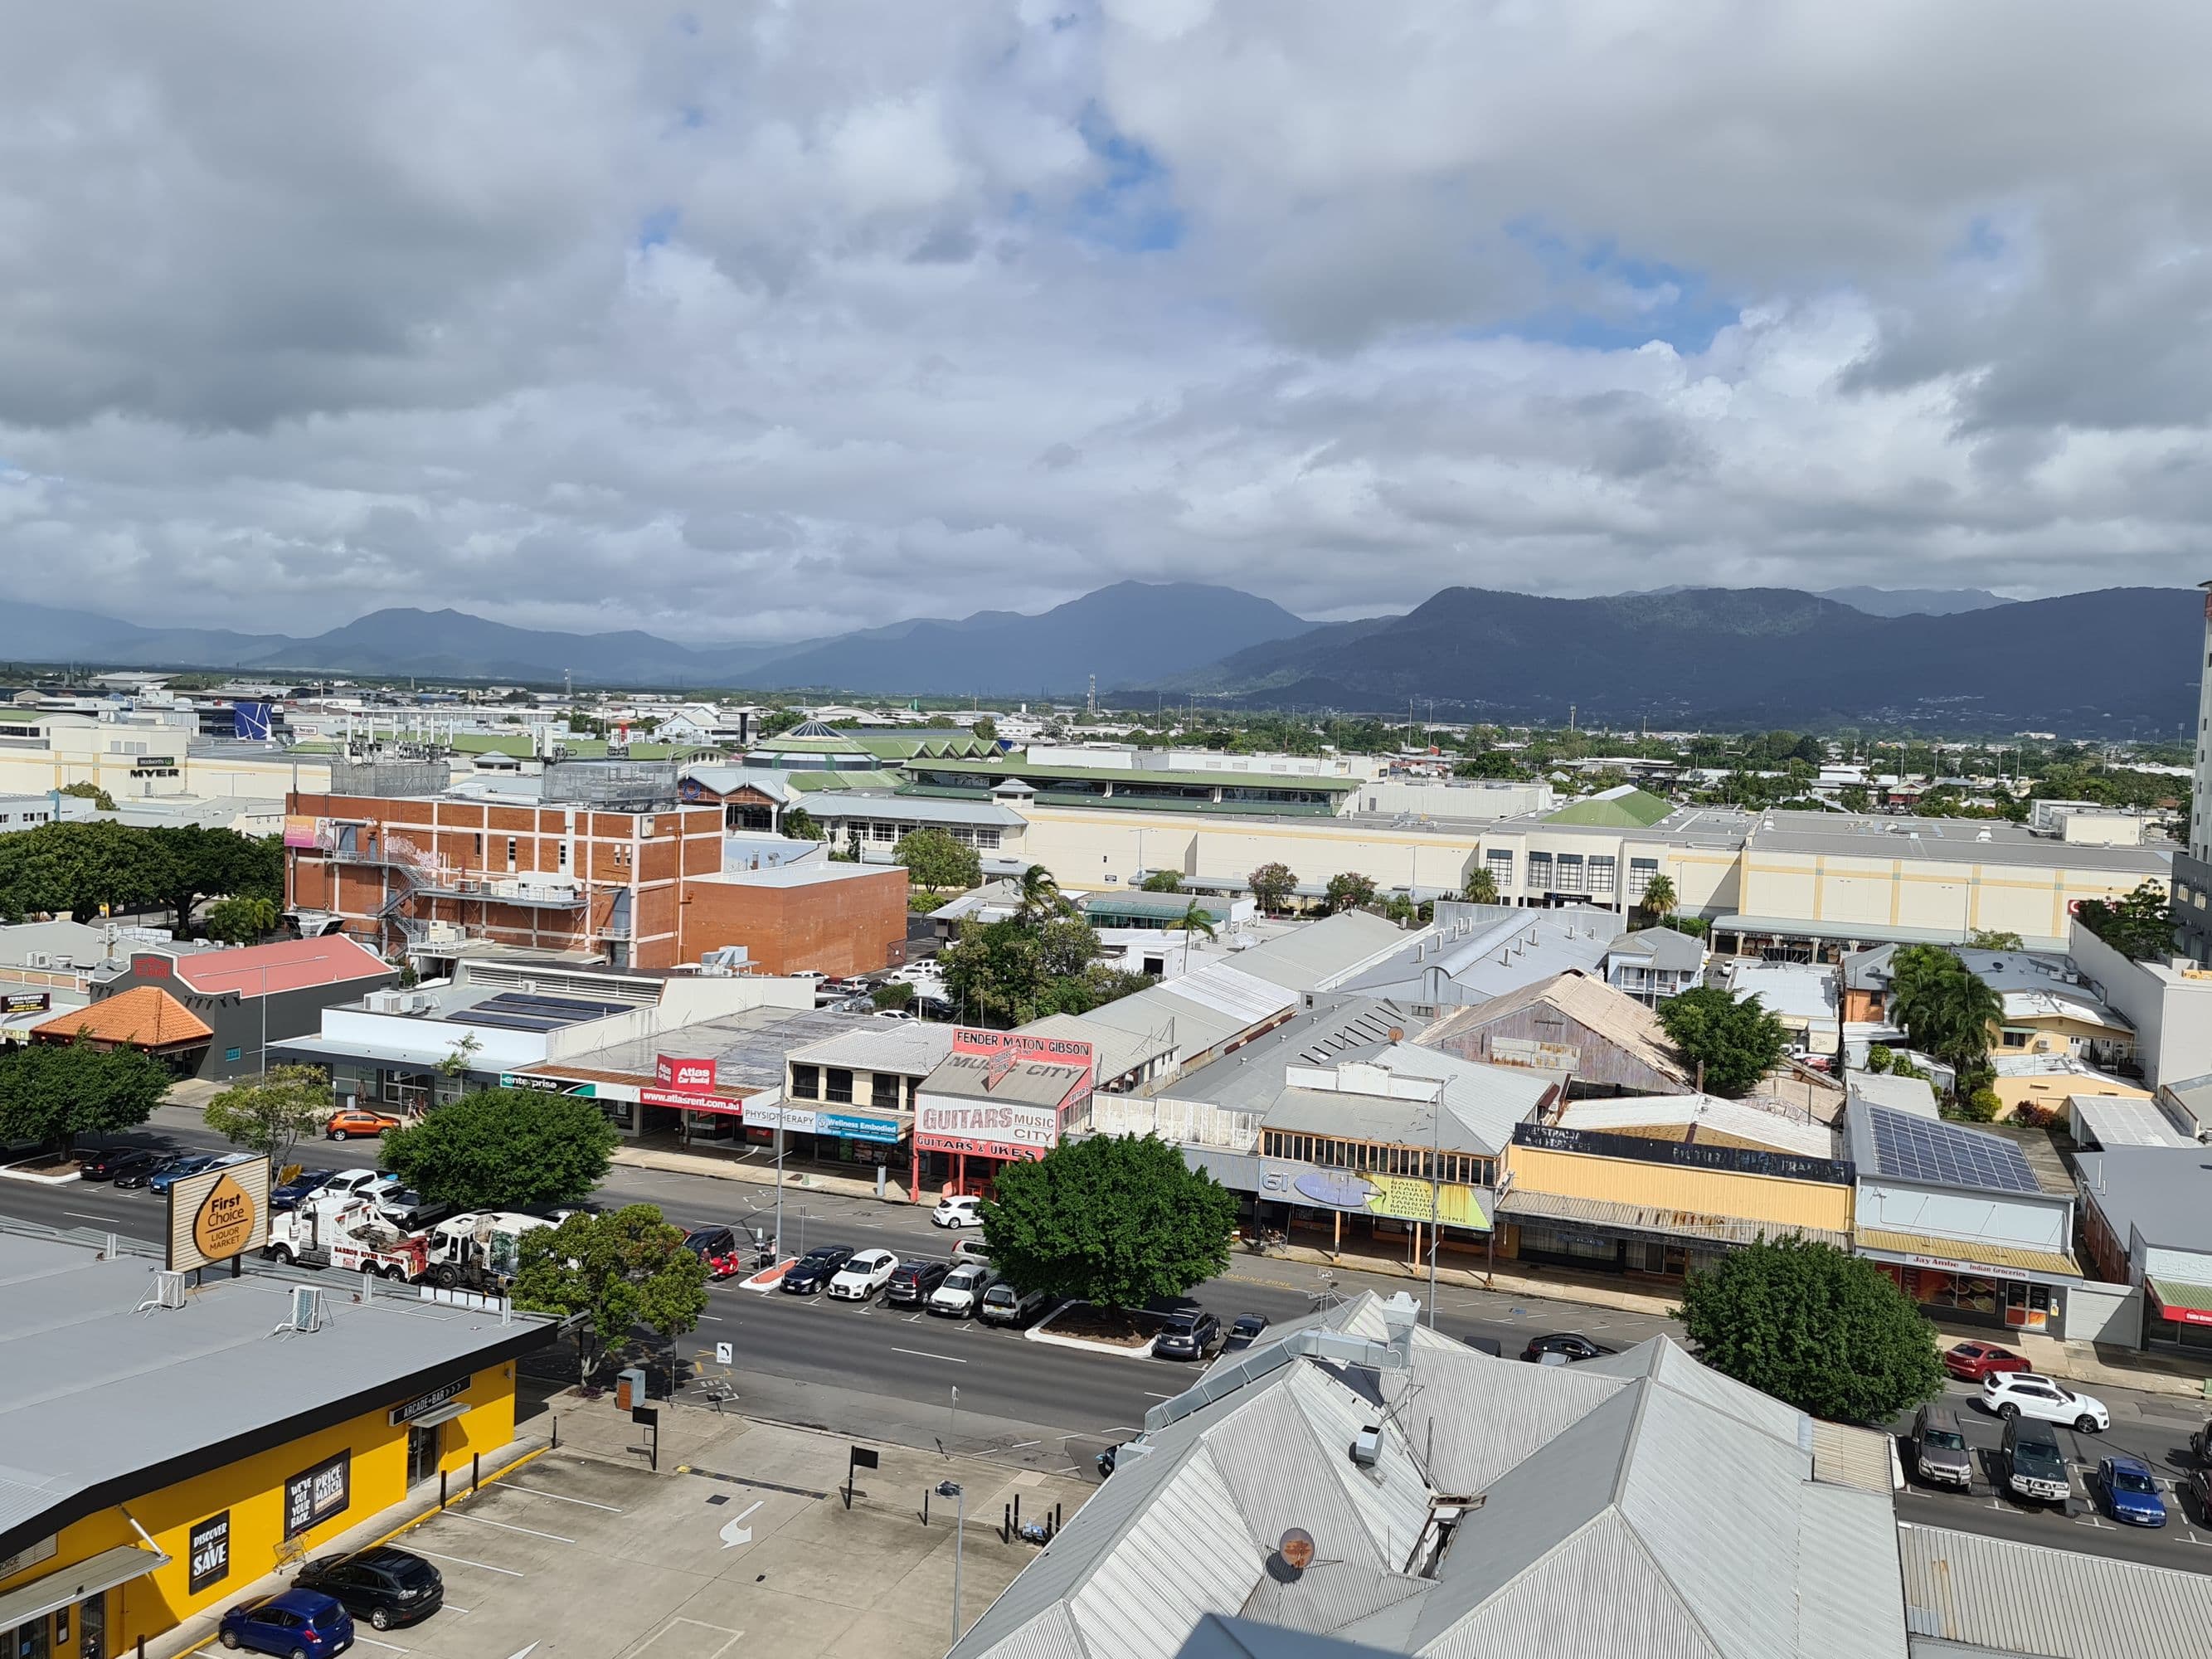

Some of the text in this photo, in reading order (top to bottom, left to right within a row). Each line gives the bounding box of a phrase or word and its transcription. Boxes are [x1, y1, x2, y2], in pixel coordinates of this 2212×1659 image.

[130, 769, 179, 778] MYER
[957, 1032, 1089, 1056] FENDER MATON GIBSON
[678, 1067, 710, 1078] Atlas
[1026, 1065, 1081, 1079] CITY
[643, 1092, 740, 1111] www.atlasrent.com.au
[745, 1109, 814, 1125] PHYSIOTHERAPY
[829, 1118, 859, 1129] Wellness
[859, 1122, 897, 1133] Embodied
[923, 1107, 1013, 1130] GUITARS
[1014, 1114, 1054, 1128] MUSIC
[1014, 1128, 1053, 1142] CITY
[916, 1135, 973, 1151] GUITARS
[978, 1144, 984, 1153] &
[990, 1145, 1036, 1160] UKES
[1262, 1170, 1289, 1193] 61
[1391, 1185, 1429, 1194] BEAUTY
[211, 1194, 241, 1213] First
[1392, 1199, 1434, 1209] TANNIN
[207, 1208, 244, 1227] Choice
[210, 1234, 240, 1251] MARKET
[211, 1227, 239, 1242] LIQUOR
[361, 1251, 378, 1260] RIVER
[381, 1255, 404, 1265] TOWING
[1913, 1256, 2026, 1277] Jay Ambe Indian Groceries
[290, 1477, 312, 1496] WE'VE
[315, 1466, 342, 1491] PRICE
[294, 1490, 308, 1505] GOT
[315, 1478, 342, 1503] MATCH
[291, 1499, 310, 1516] YOUR
[193, 1522, 227, 1548] DISCOVER
[193, 1542, 226, 1576] SAVE
